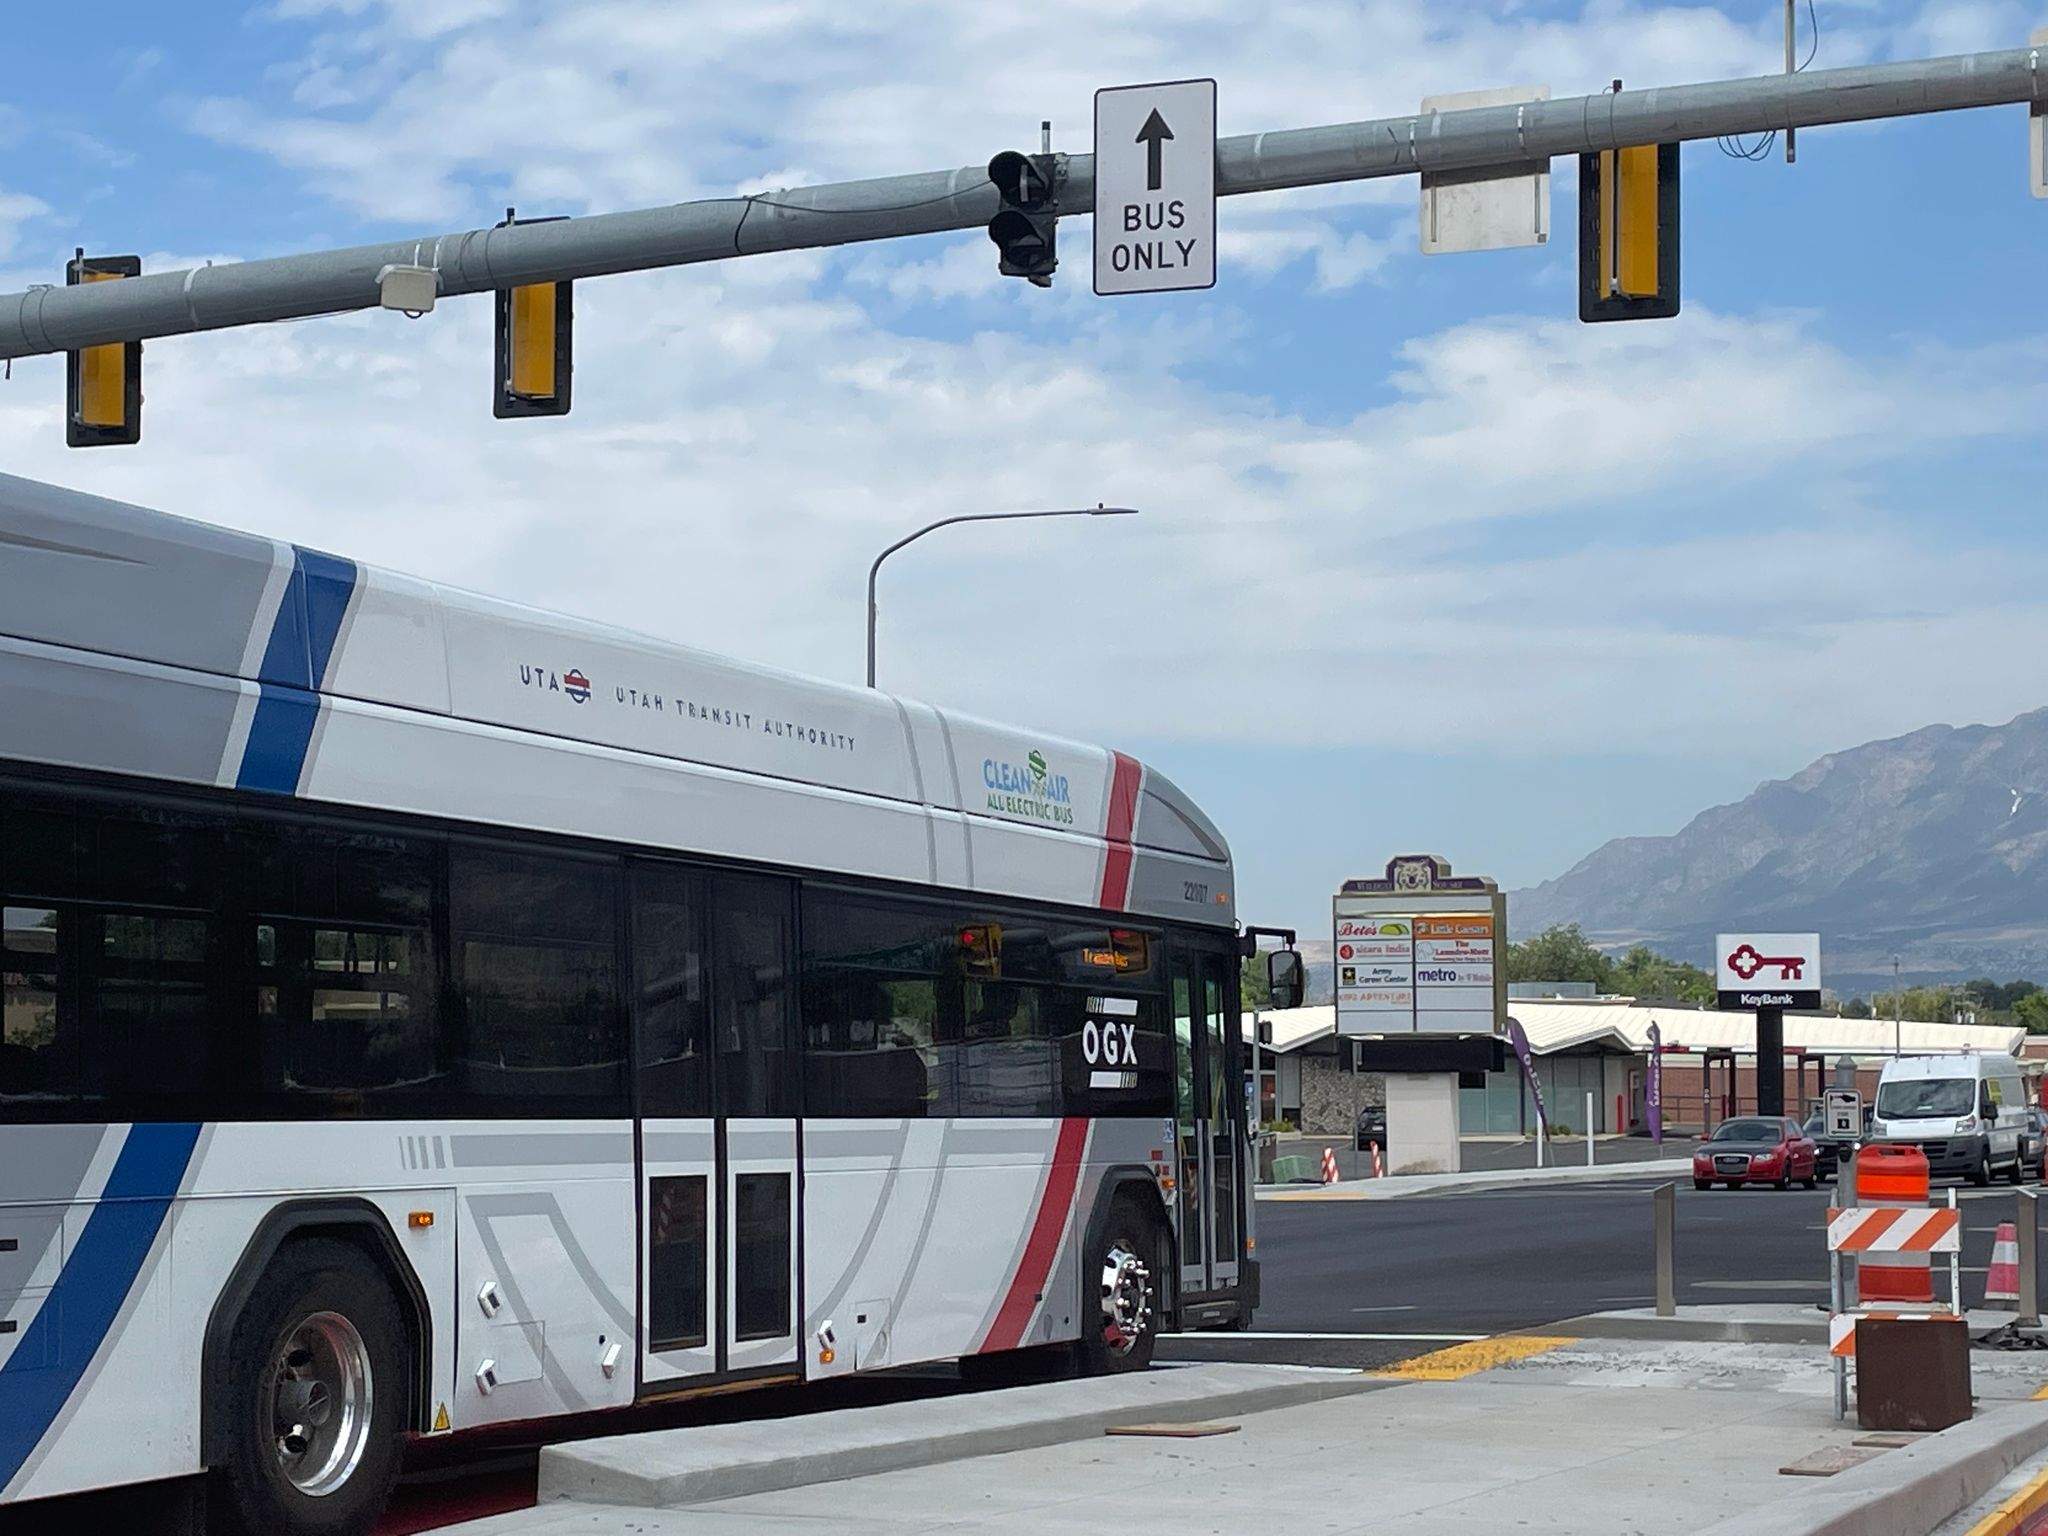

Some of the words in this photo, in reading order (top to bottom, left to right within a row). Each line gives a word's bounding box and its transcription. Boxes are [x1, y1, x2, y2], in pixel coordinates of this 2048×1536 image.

[1124, 200, 1185, 232] BUS
[1112, 238, 1197, 272] ONLY
[520, 664, 560, 692] UTA
[615, 686, 664, 711] UTAH
[676, 699, 752, 729] TRANSIT
[764, 719, 856, 752] AUTHORITY
[983, 758, 1032, 795] CLEAN
[1047, 774, 1071, 804] AIR
[987, 793, 1005, 811] ALL
[1006, 796, 1051, 820] ELECTRIC
[1053, 805, 1073, 825] BUS
[1418, 968, 1457, 982] metro
[1740, 993, 1794, 1007] KeyBank
[1082, 1020, 1138, 1065] OGX
